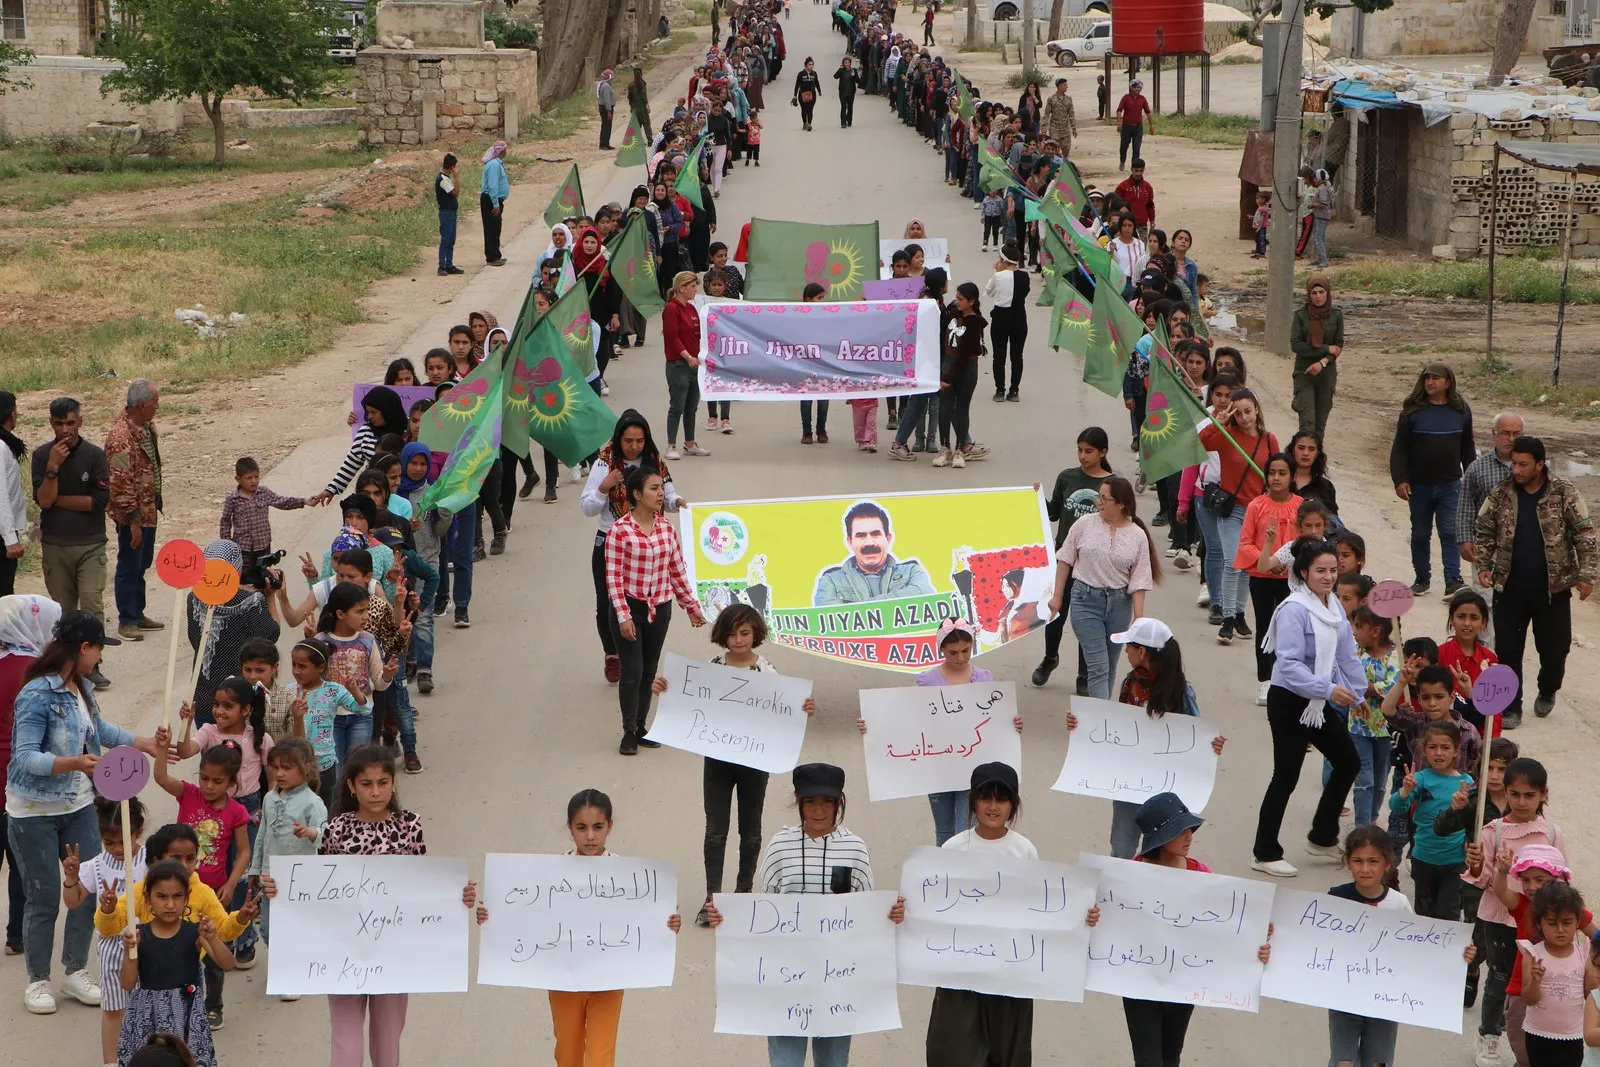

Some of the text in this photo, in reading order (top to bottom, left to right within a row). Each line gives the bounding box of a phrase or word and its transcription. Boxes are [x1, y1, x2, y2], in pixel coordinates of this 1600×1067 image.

[719, 336, 904, 362] Jin Jiyan Azadî
[163, 553, 197, 573] الحياة
[201, 573, 231, 587] الحرية
[776, 594, 961, 634] JIN JIYAN AZADÎ
[778, 634, 878, 661] SERBIXE
[682, 665, 711, 699] Em
[928, 689, 1004, 715] هي فتاة
[1153, 723, 1195, 754] لا
[1078, 770, 1176, 793] الطفولة
[288, 863, 311, 901] Em
[549, 878, 572, 909] هم
[922, 871, 1066, 912] لا لجرائم
[504, 885, 540, 906] ربيع
[421, 914, 442, 925] me
[750, 900, 854, 934] Dest nede
[1153, 890, 1247, 934] الحرية
[510, 922, 641, 962] الحياة الحرة
[1369, 926, 1388, 952] ji
[308, 961, 327, 979] ne
[758, 957, 766, 984] li
[1182, 954, 1214, 967] من
[1307, 948, 1334, 971] dest
[830, 1003, 856, 1015] min
